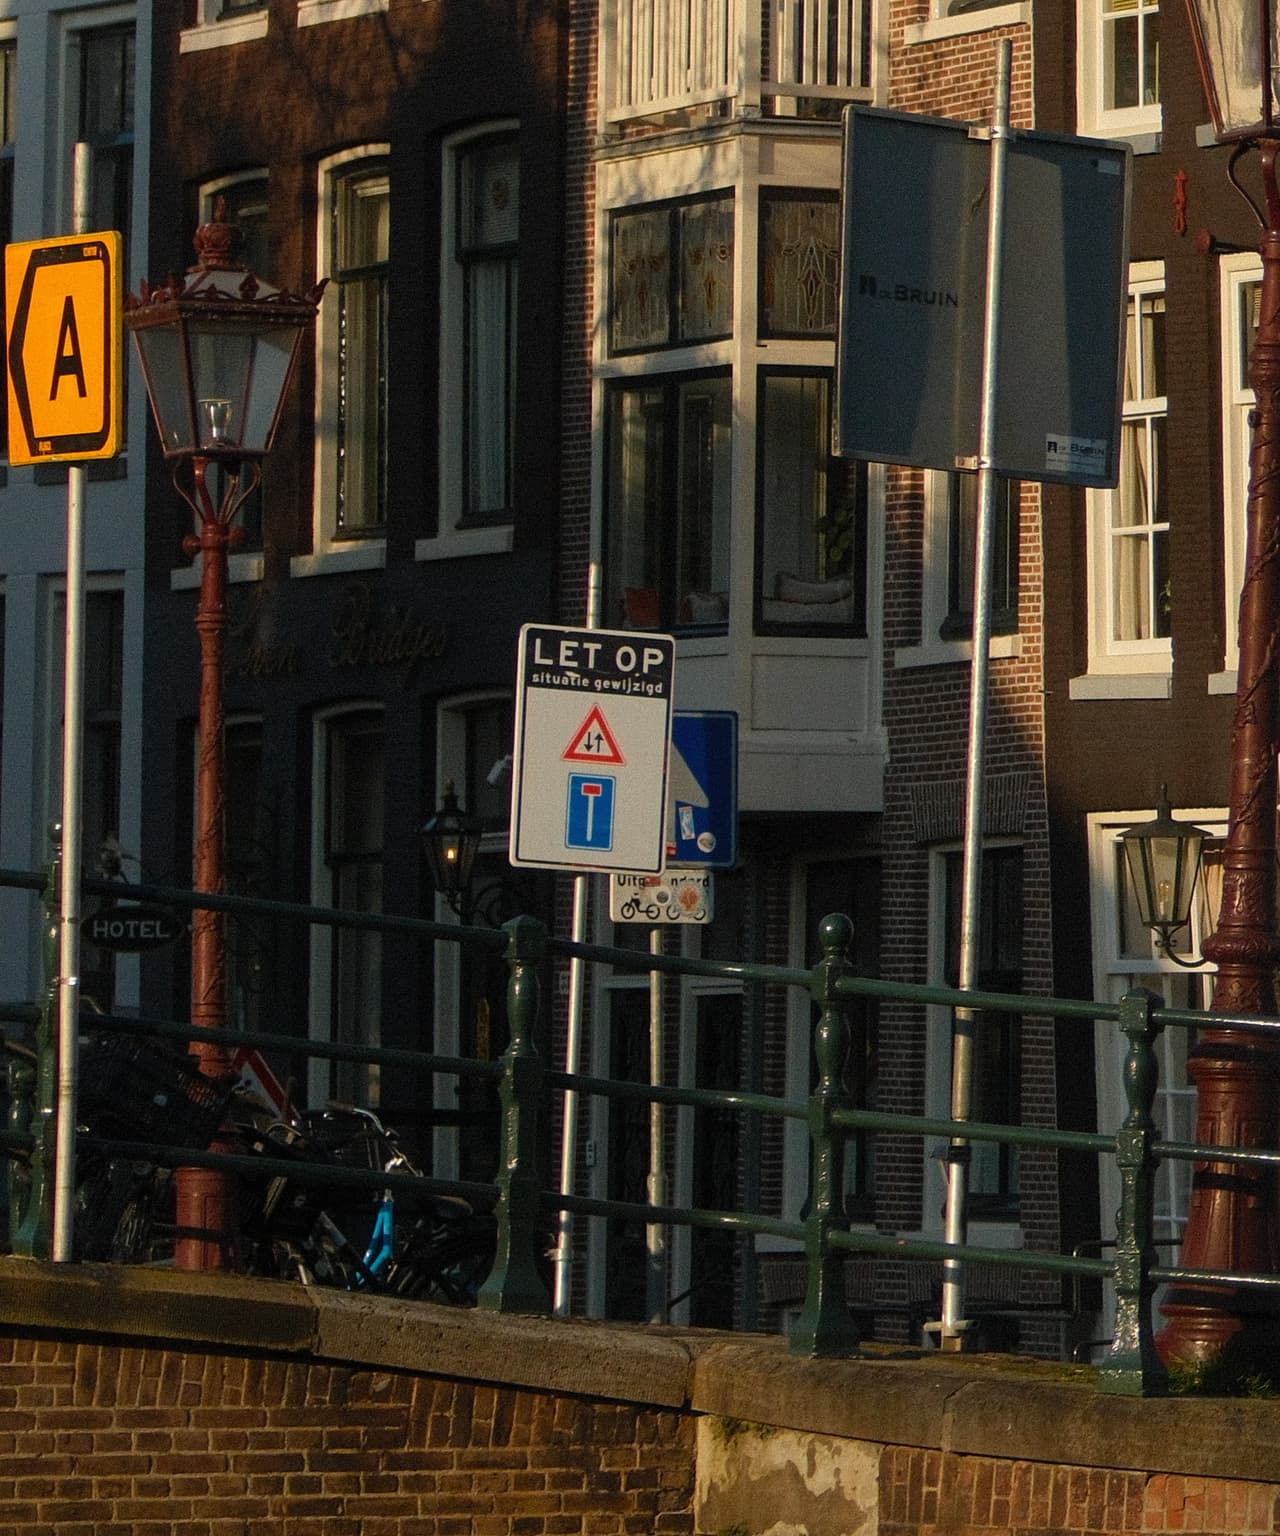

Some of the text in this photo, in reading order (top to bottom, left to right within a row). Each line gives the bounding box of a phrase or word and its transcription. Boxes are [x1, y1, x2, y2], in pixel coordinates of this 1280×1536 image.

[895, 283, 959, 308] BRUIN
[49, 295, 88, 401] A
[534, 638, 664, 674] LET OP
[532, 671, 663, 696] situatie gewijzigd
[93, 919, 171, 938] HOTEL
